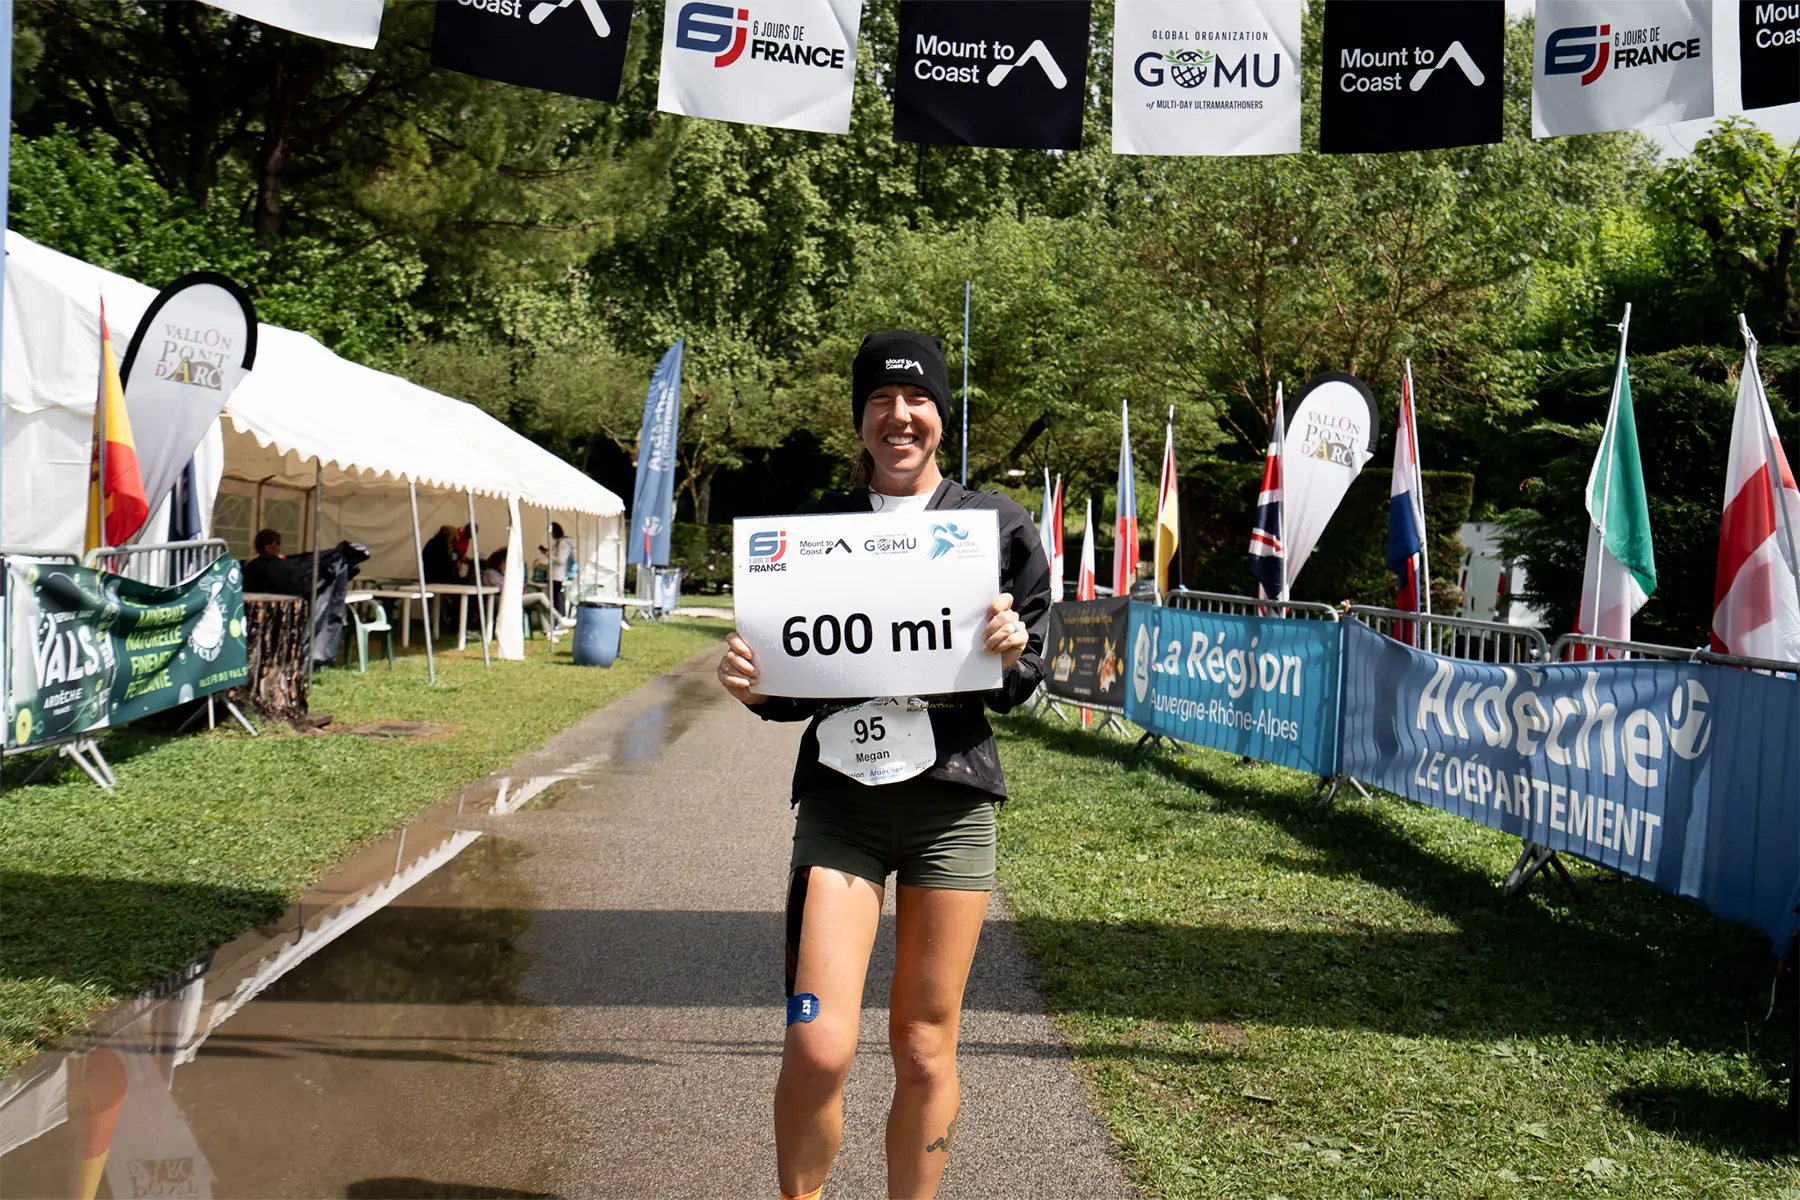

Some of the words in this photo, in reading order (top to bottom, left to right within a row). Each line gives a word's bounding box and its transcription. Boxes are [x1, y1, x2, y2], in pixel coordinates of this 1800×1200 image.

[456, 0, 522, 18] oast
[752, 20, 759, 36] 6
[761, 22, 791, 40] JOURS
[793, 25, 805, 41] DE
[1152, 30, 1190, 40] GLOBAL
[1194, 31, 1269, 41] ORGANIZATION
[1614, 32, 1620, 47] 6
[1622, 28, 1648, 46] JOURS
[1650, 27, 1660, 42] DE
[751, 38, 845, 69] FRANCE
[915, 33, 987, 59] Mount
[992, 41, 1015, 60] to
[1340, 47, 1408, 69] Mount
[1413, 46, 1435, 65] to
[1614, 38, 1701, 69] FRANCE
[914, 59, 980, 83] Coast
[1340, 72, 1402, 92] Coast
[1146, 101, 1155, 110] of
[1156, 100, 1193, 109] MULTI-DAY
[1194, 100, 1264, 109] ULTRAMARATHONERS
[165, 324, 232, 350] VALLON
[158, 340, 230, 369] PONT
[1308, 411, 1361, 435] VALLON
[1304, 424, 1358, 449] PONT
[749, 563, 787, 573] FRANCE
[125, 625, 183, 652] NATURELLE
[782, 612, 873, 657] 600
[891, 607, 952, 652] mi
[28, 612, 100, 690] VALS
[1151, 626, 1181, 676] La
[1187, 630, 1302, 699] Région
[1150, 689, 1298, 742] Auvergne-Rhône-Alpes
[1416, 658, 1664, 789] Ardèche
[854, 716, 886, 744] 95
[856, 750, 890, 763] Megan
[1414, 747, 1441, 792] LE
[1443, 753, 1662, 864] DÉPARTEMENT
